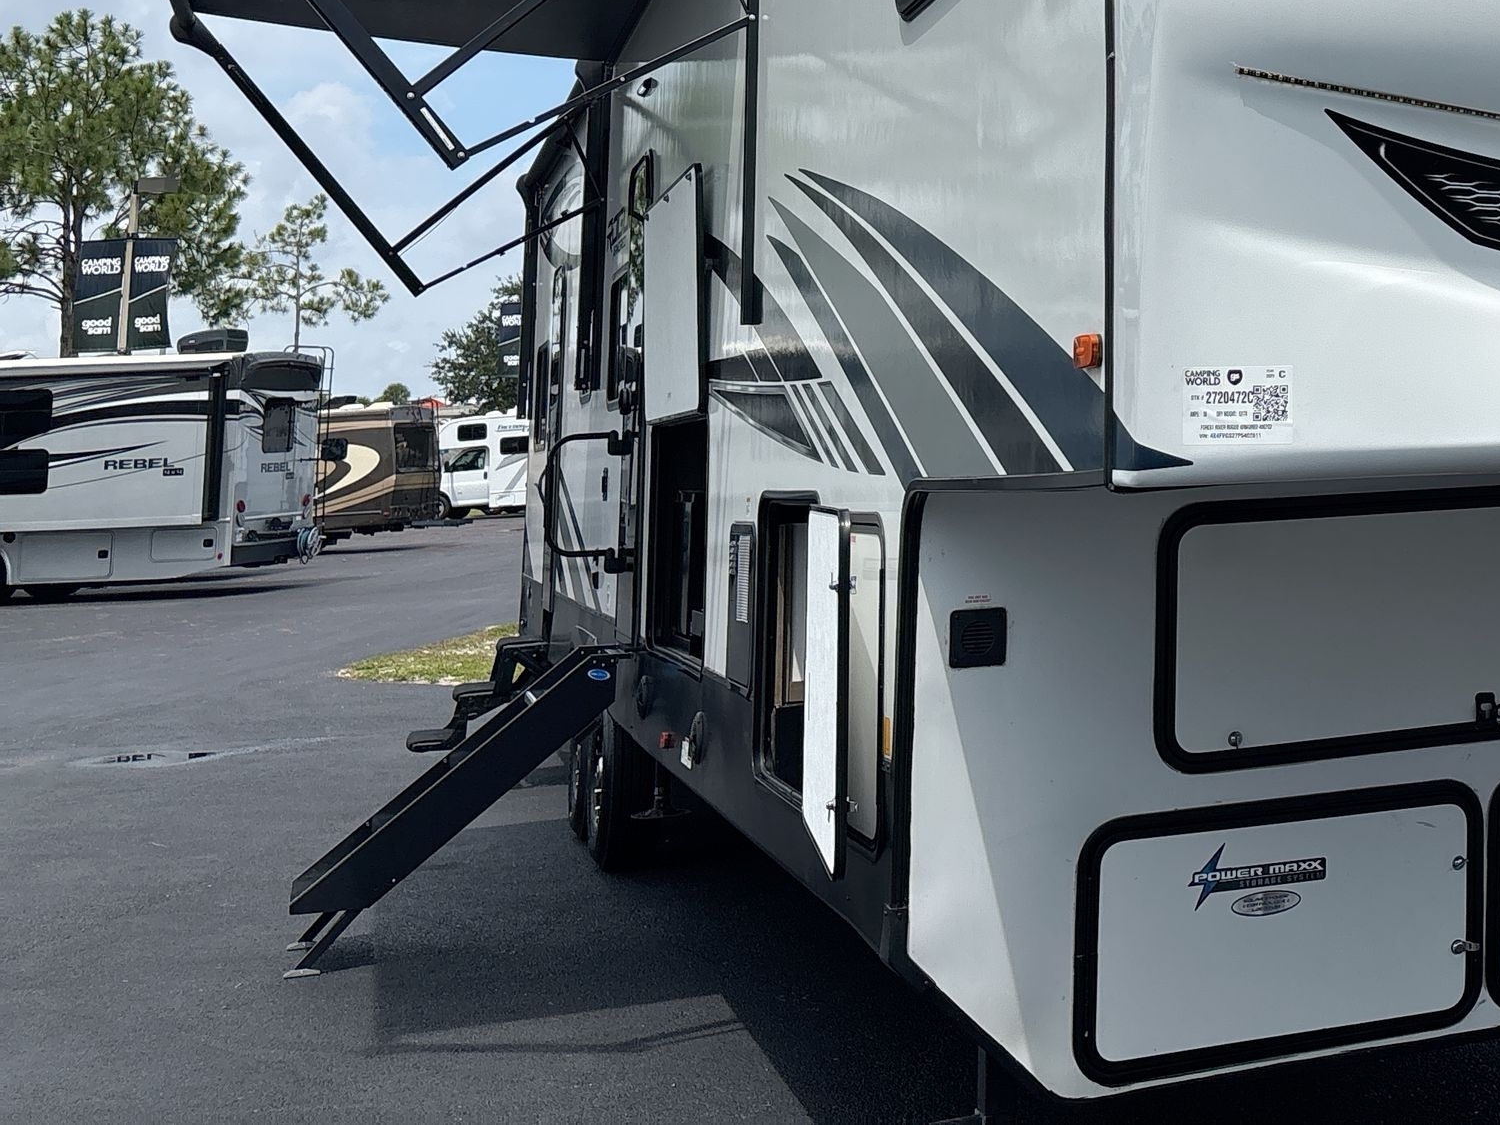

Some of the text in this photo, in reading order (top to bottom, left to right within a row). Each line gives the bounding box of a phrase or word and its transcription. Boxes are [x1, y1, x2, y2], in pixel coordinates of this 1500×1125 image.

[81, 257, 121, 267] CAMPING
[134, 256, 170, 264] CAMPING
[82, 265, 121, 275] WORLD
[134, 263, 169, 273] WORLD
[81, 317, 112, 330] good
[134, 314, 161, 328] good
[87, 326, 112, 336] sam
[139, 323, 161, 333] sam
[1185, 370, 1221, 378] CAMPING
[1186, 377, 1221, 386] WORLD
[104, 458, 175, 470] REBEL
[261, 462, 291, 472] REBEL
[1194, 859, 1324, 883] POWER MAXX
[1240, 872, 1324, 888] STORAGE SYSTEM
